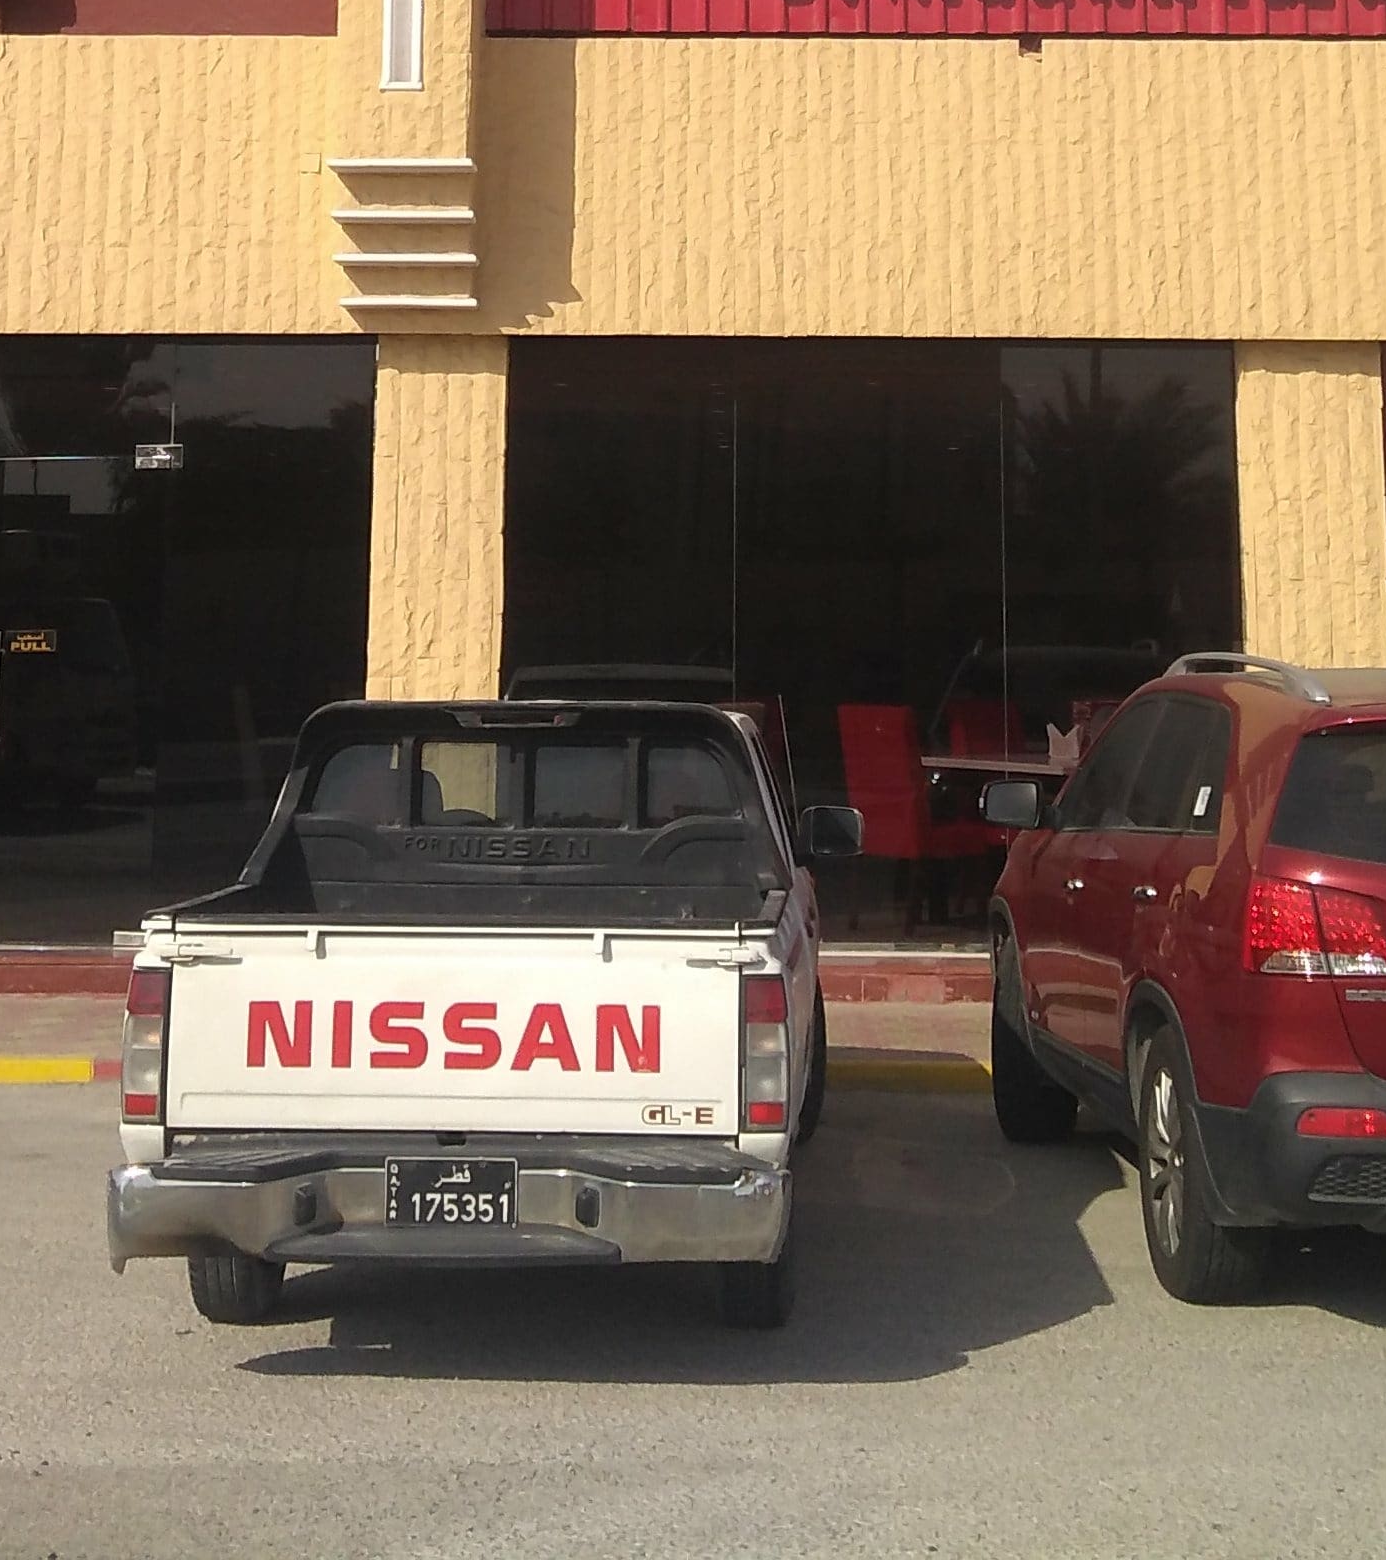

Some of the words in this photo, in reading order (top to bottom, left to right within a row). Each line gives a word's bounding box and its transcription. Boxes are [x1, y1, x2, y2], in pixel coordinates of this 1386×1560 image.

[10, 641, 51, 652] PULL
[447, 836, 591, 859] NISSAN
[246, 1000, 661, 1074] NISSAN
[431, 1163, 471, 1188] قطر
[389, 1163, 401, 1220] QATAR
[411, 1192, 509, 1223] 175351
